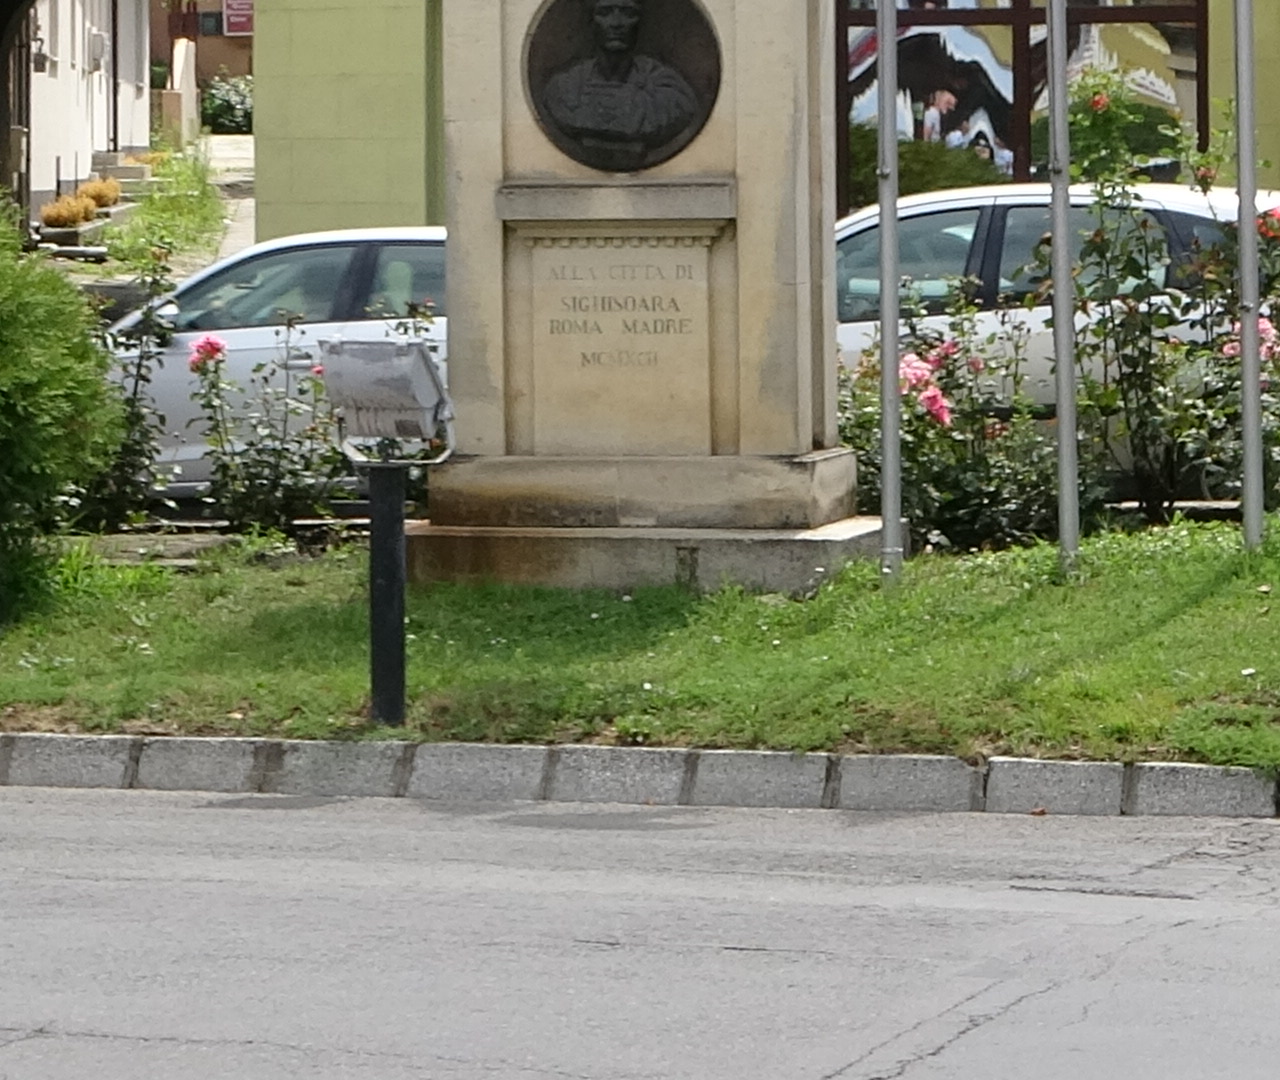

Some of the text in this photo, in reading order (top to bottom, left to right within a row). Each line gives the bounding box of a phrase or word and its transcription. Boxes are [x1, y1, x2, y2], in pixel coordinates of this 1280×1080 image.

[675, 264, 694, 280] DI
[549, 318, 693, 335] ROMA MADRE
